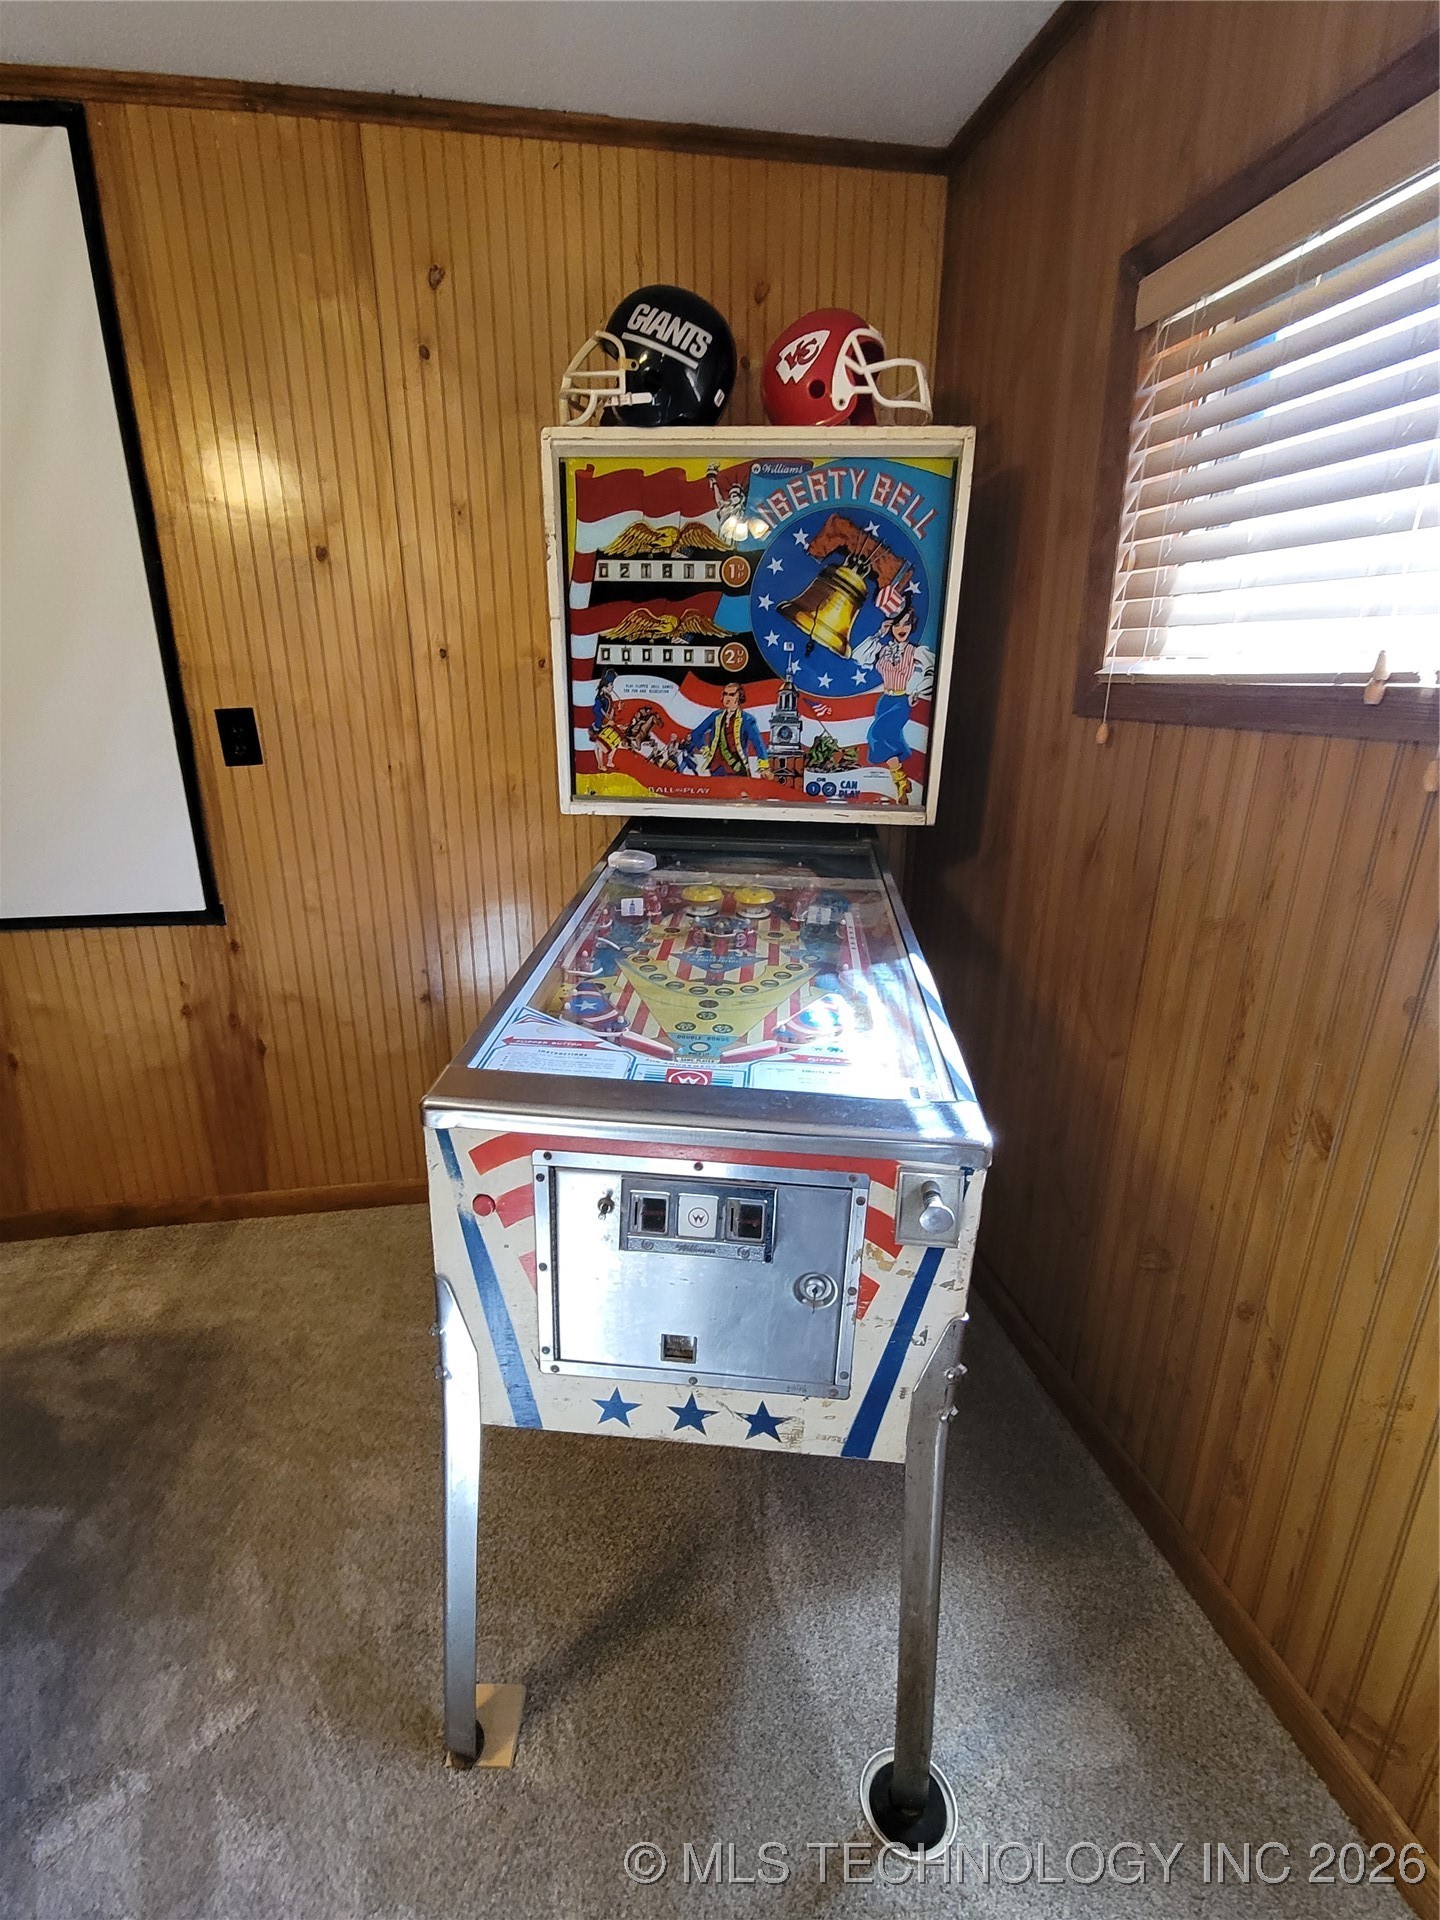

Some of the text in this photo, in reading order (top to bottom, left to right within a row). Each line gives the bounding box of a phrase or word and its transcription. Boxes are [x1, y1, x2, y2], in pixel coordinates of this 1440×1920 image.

[627, 303, 713, 359] GIANTS
[761, 464, 805, 475] Williams
[869, 472, 940, 541] BELL
[648, 786, 674, 794] BALL
[840, 780, 858, 790] CAN
[838, 789, 861, 798] PLAY
[537, 1049, 589, 1057] INSTRUCTIONS
